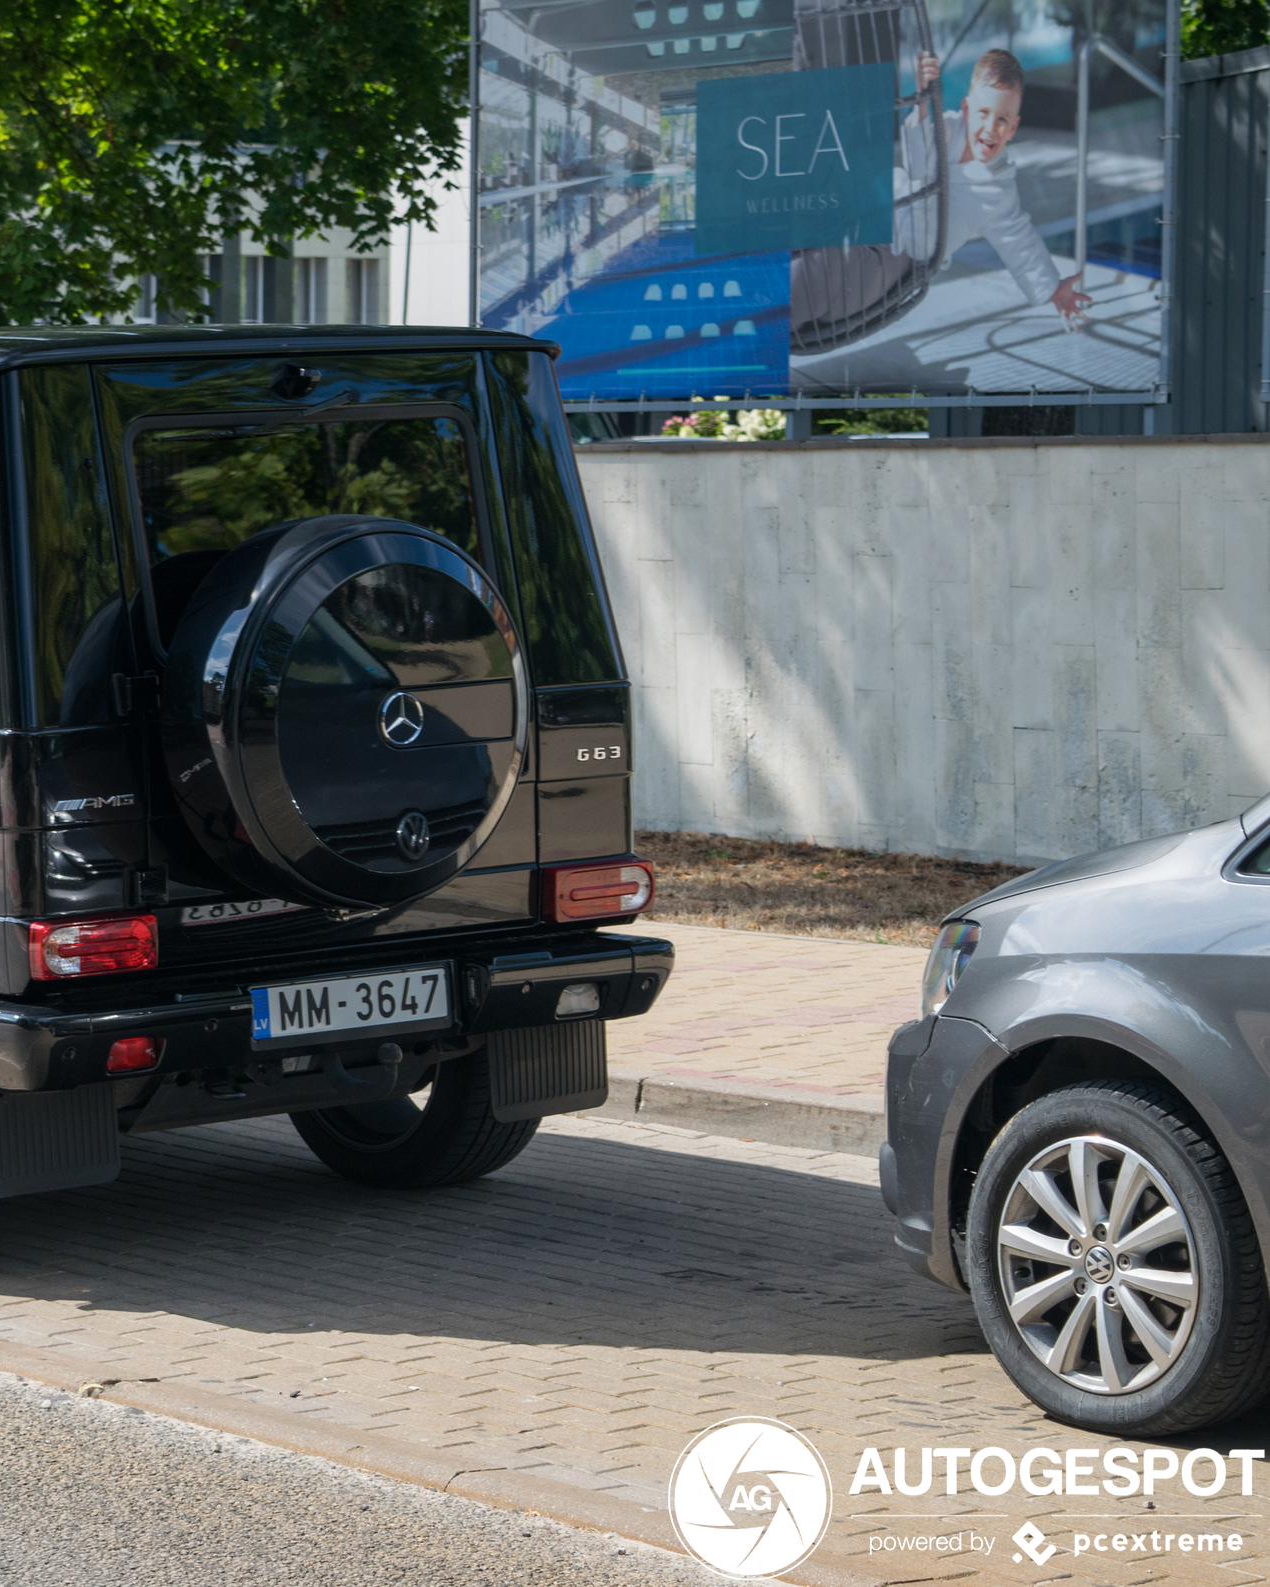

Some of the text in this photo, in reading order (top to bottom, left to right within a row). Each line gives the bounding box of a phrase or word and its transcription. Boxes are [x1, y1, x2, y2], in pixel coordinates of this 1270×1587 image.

[736, 109, 850, 180] SEA
[746, 194, 840, 213] WELLNESS
[79, 793, 135, 810] AMG
[279, 973, 439, 1032] MM-3647
[253, 1018, 268, 1031] LV
